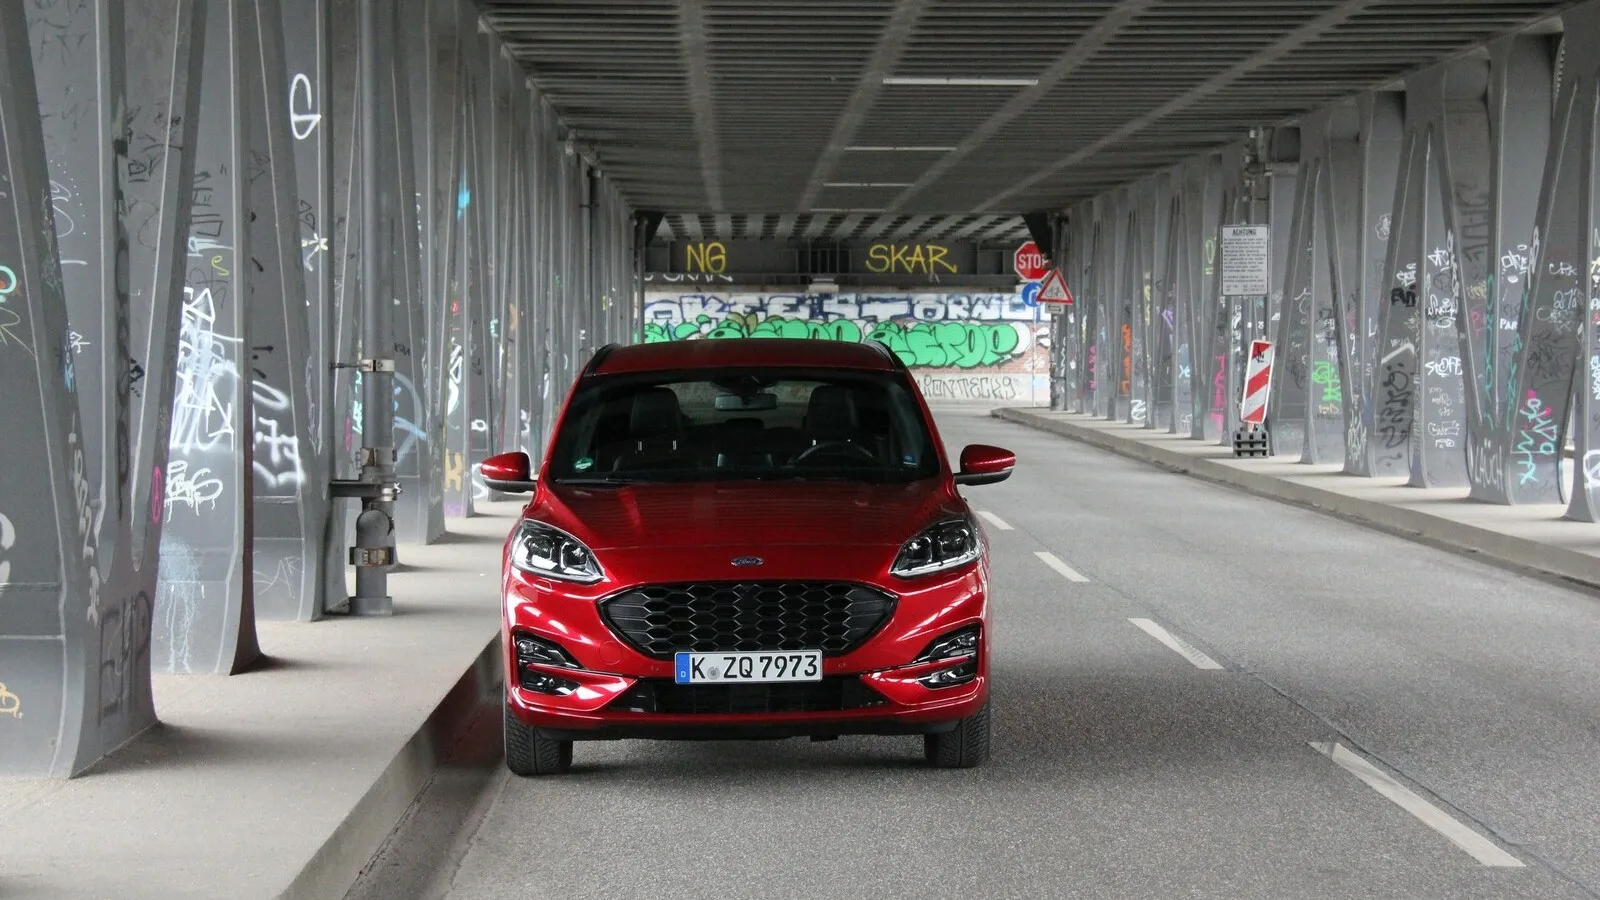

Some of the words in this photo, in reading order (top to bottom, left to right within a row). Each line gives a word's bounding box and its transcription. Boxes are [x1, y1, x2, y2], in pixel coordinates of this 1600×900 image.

[686, 242, 727, 273] NG
[865, 243, 958, 274] SKAR
[691, 657, 706, 679] K
[723, 656, 753, 678] ZQ
[759, 655, 817, 678] 7973
